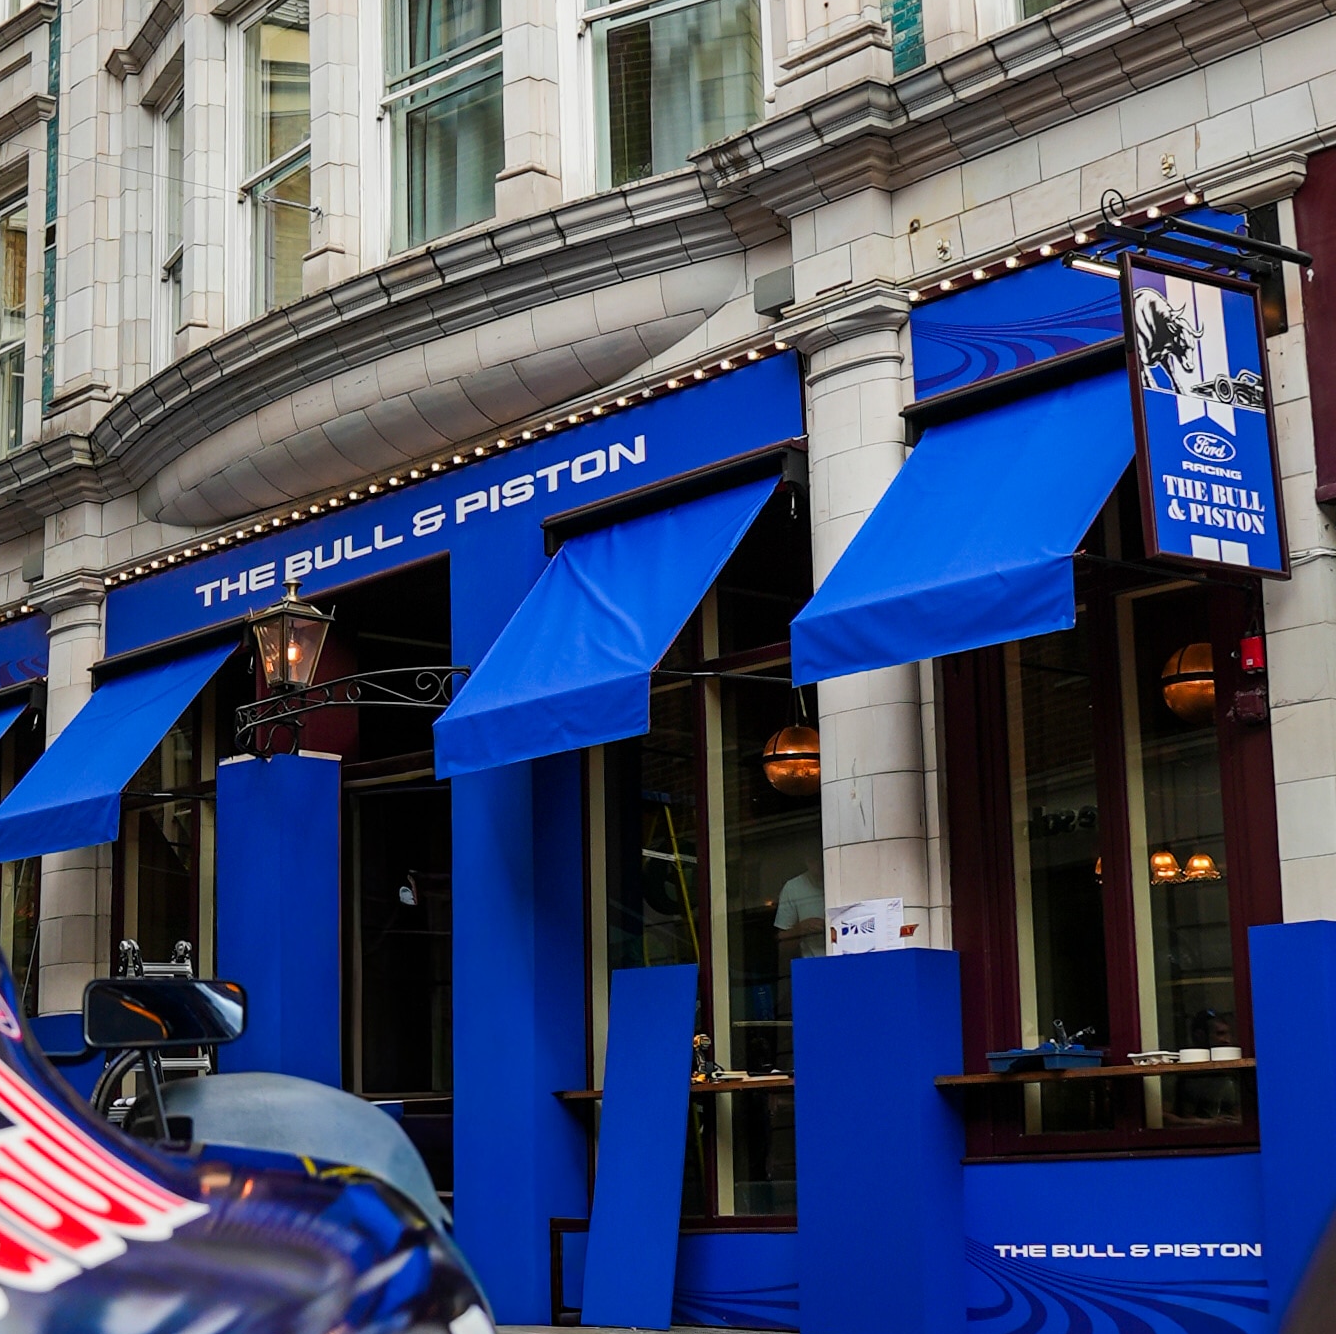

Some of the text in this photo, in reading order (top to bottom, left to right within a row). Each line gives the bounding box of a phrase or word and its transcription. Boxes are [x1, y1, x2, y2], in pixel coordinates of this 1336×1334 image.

[1193, 435, 1226, 458] Ford
[1181, 460, 1243, 481] RACING
[1162, 474, 1266, 512] THE BULL
[195, 434, 646, 607] THE BULL & PISTON
[1167, 498, 1266, 535] & PISTON
[993, 1242, 1263, 1258] THE BULL & PISTON
